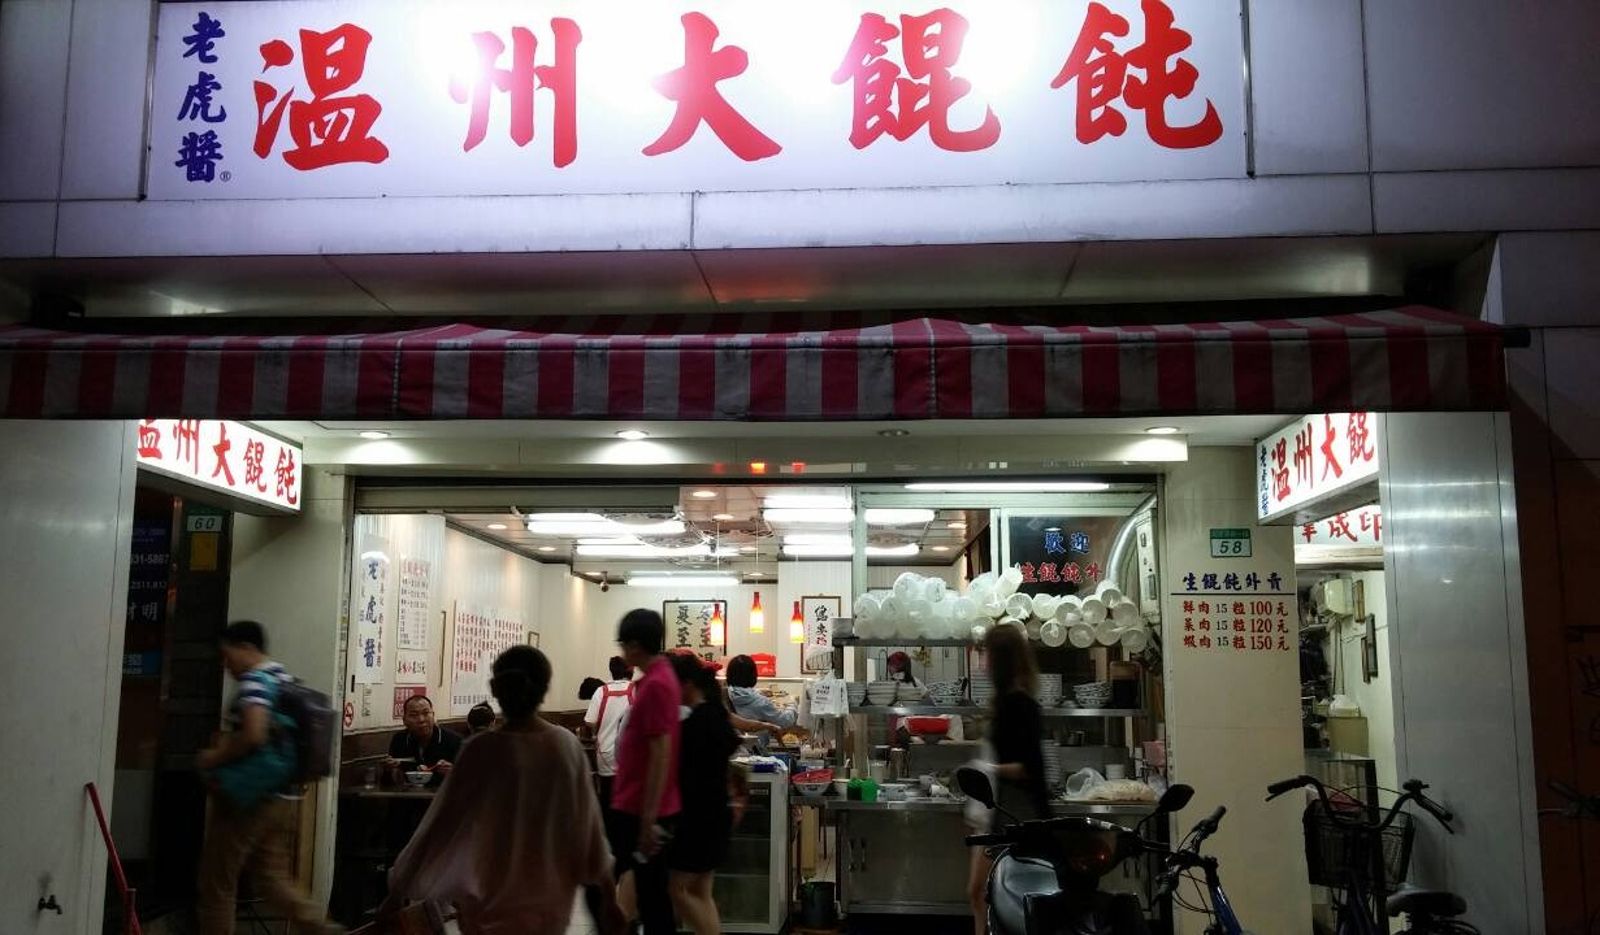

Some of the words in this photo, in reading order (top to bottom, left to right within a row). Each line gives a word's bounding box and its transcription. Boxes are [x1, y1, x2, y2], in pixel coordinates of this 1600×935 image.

[175, 12, 228, 184] 老虎醬
[194, 517, 216, 529] 60
[1044, 531, 1090, 554] 歡迎
[1219, 540, 1242, 554] 58
